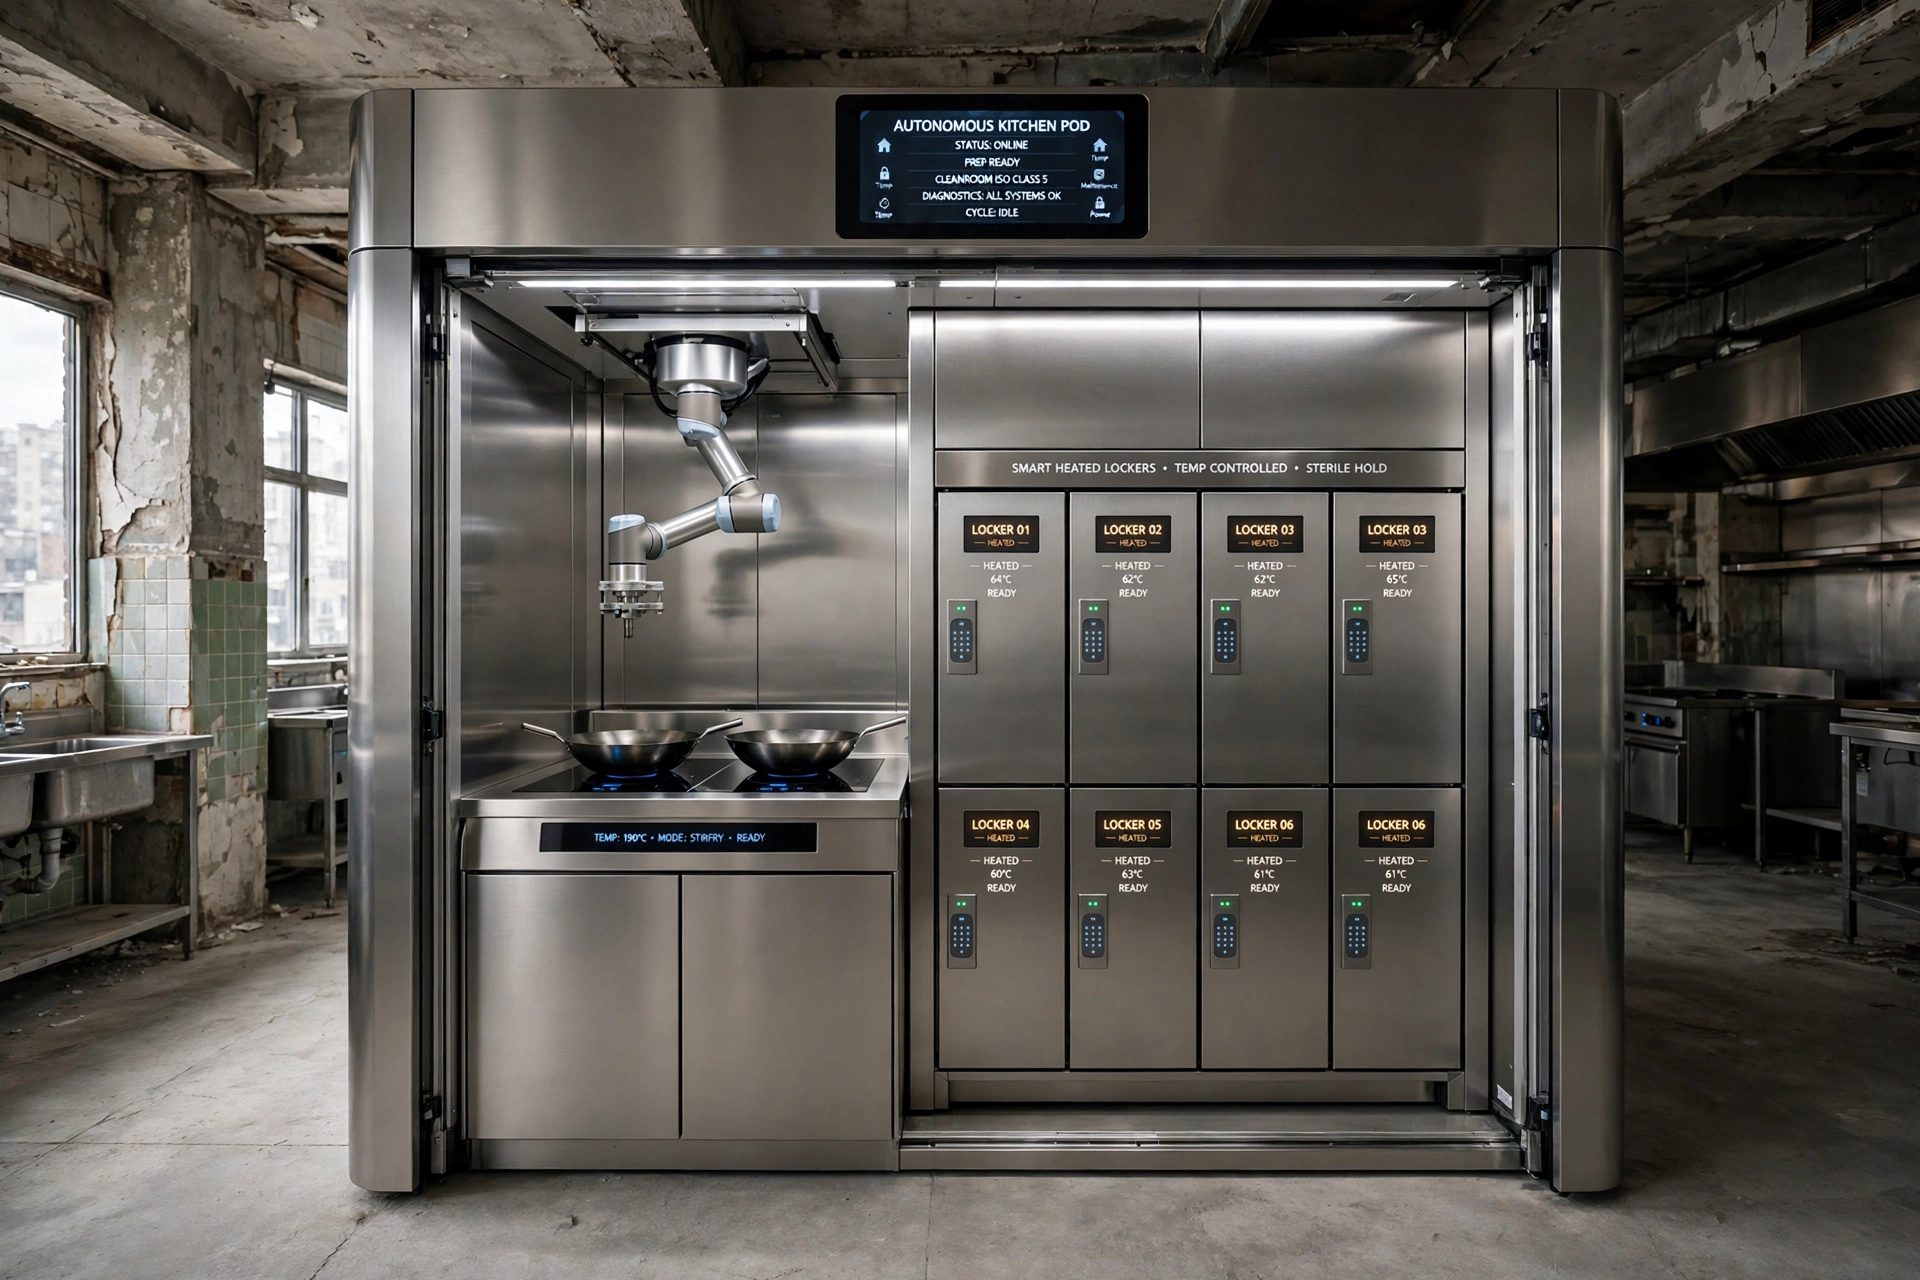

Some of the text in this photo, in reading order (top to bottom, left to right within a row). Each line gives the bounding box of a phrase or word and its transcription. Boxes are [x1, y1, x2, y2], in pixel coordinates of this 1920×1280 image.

[893, 119, 1091, 133] AUTONOMOUS KITCHEN POD
[954, 139, 1029, 151] STATUS: ONLINE
[964, 157, 1021, 168] PREP READY
[934, 174, 1048, 185] CLEANROOM ISO CLASS 5
[922, 190, 1062, 201] DIAGNOSTICS: ALL SYSTEMS OK
[965, 207, 1019, 218] CYCLE: IDLE
[1011, 462, 1388, 474] SMART HEATED LOCKERS TEMP CONTROLLED STERILE HOLD
[971, 524, 1030, 536] LOCKER 01
[1103, 524, 1163, 536] LOCKER 02
[1235, 524, 1295, 536] LOCKER 03
[1367, 524, 1427, 536] LOCKER 03
[983, 561, 1020, 571] HEATED
[1115, 561, 1151, 571] HEATED
[1247, 561, 1284, 571] HEATED
[1379, 561, 1416, 571] HEATED
[987, 588, 1017, 598] READY
[1119, 588, 1148, 598] READY
[1250, 588, 1281, 598] READY
[1383, 588, 1413, 598] READY
[972, 818, 1030, 831] LOCKER 04
[1103, 819, 1162, 831] LOCKER 05
[1235, 819, 1294, 831] LOCKER 06
[1367, 819, 1426, 831] LOCKER 06
[594, 832, 620, 842] TEMP:
[657, 832, 687, 843] MODE:
[736, 832, 766, 843] READY
[983, 855, 1020, 866] HEATED
[1114, 855, 1151, 866] HEATED
[1246, 855, 1283, 866] HEATED
[1378, 855, 1416, 866] HEATED
[987, 883, 1017, 893] READY
[1118, 883, 1149, 893] READY
[1250, 883, 1280, 893] READY
[1382, 883, 1412, 893] READY
